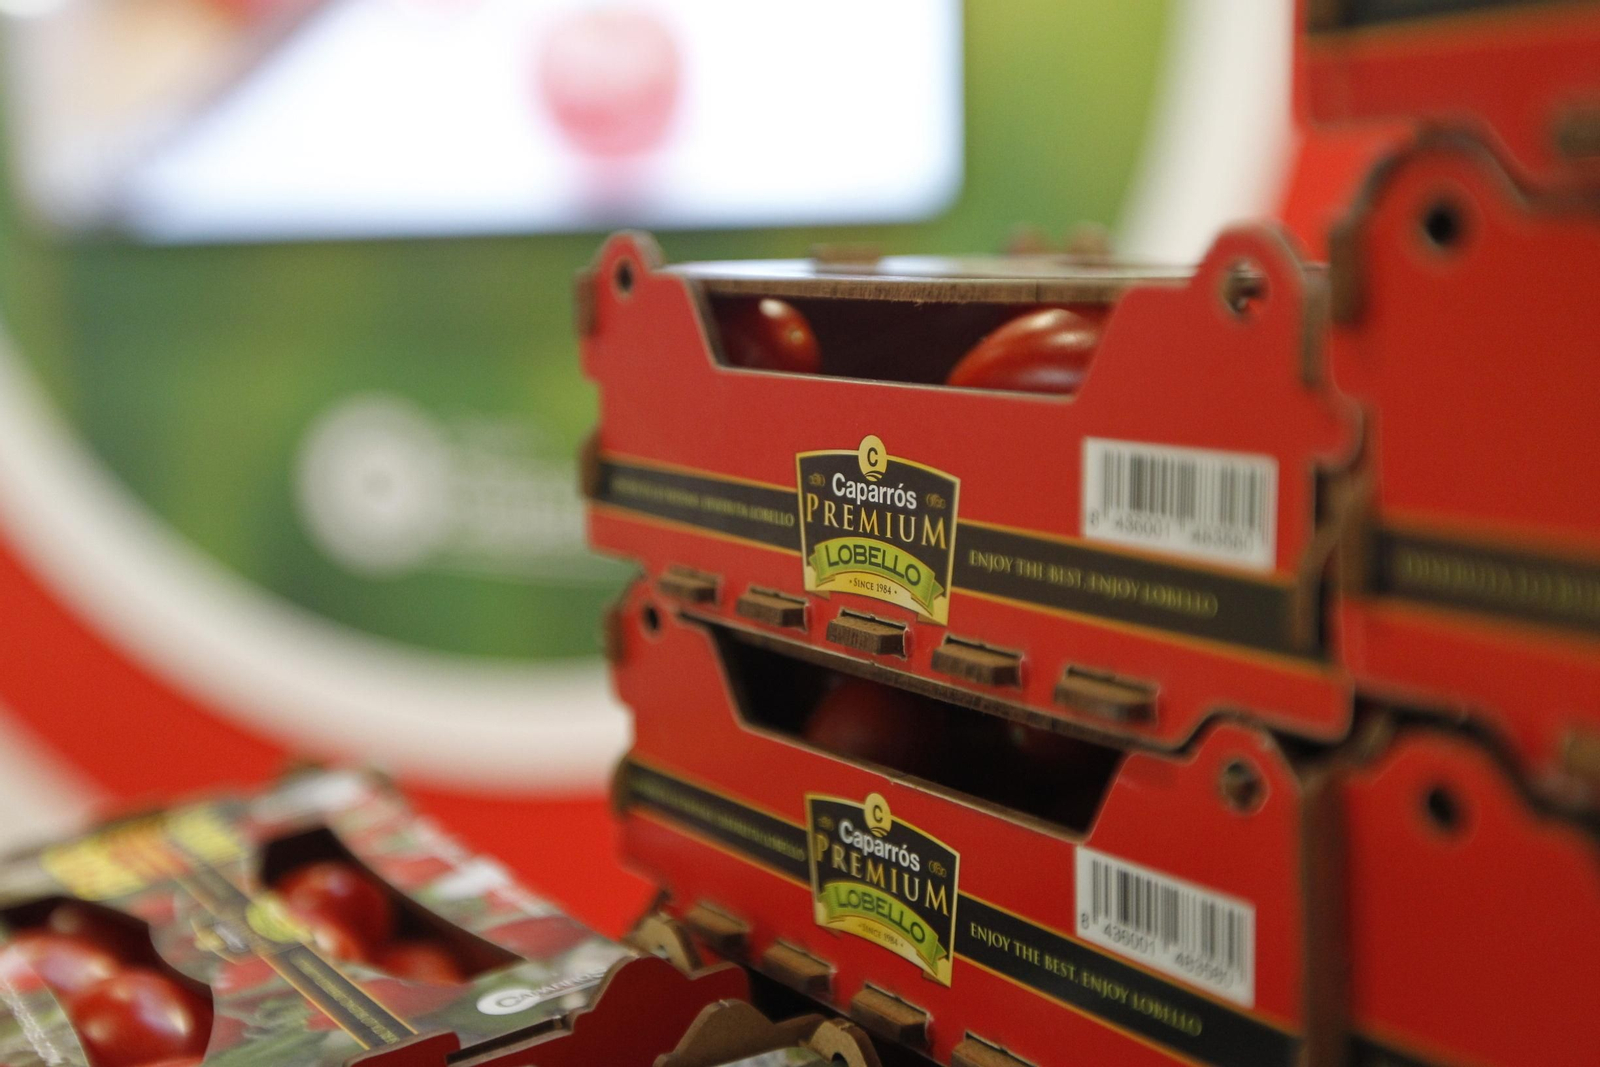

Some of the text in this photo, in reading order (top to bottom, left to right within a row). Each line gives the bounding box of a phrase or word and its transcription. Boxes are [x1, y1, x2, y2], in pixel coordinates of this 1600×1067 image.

[867, 447, 878, 467] C
[832, 472, 917, 509] Caparrós
[806, 492, 947, 549] PREMIUM
[825, 544, 921, 586] LOBELLO
[969, 550, 1014, 573] ENJOY
[1015, 557, 1043, 580] THE
[1089, 573, 1140, 601] ENJOY
[876, 583, 892, 594] 1984
[872, 804, 883, 824] C
[838, 821, 920, 872] Caparrós
[814, 833, 950, 917] PREMIUM
[834, 886, 925, 944] LOBELLO
[1081, 911, 1090, 931] 8
[970, 922, 1011, 951] ENJOY
[1013, 940, 1041, 966] THE
[1081, 971, 1130, 1004] ENJOY
